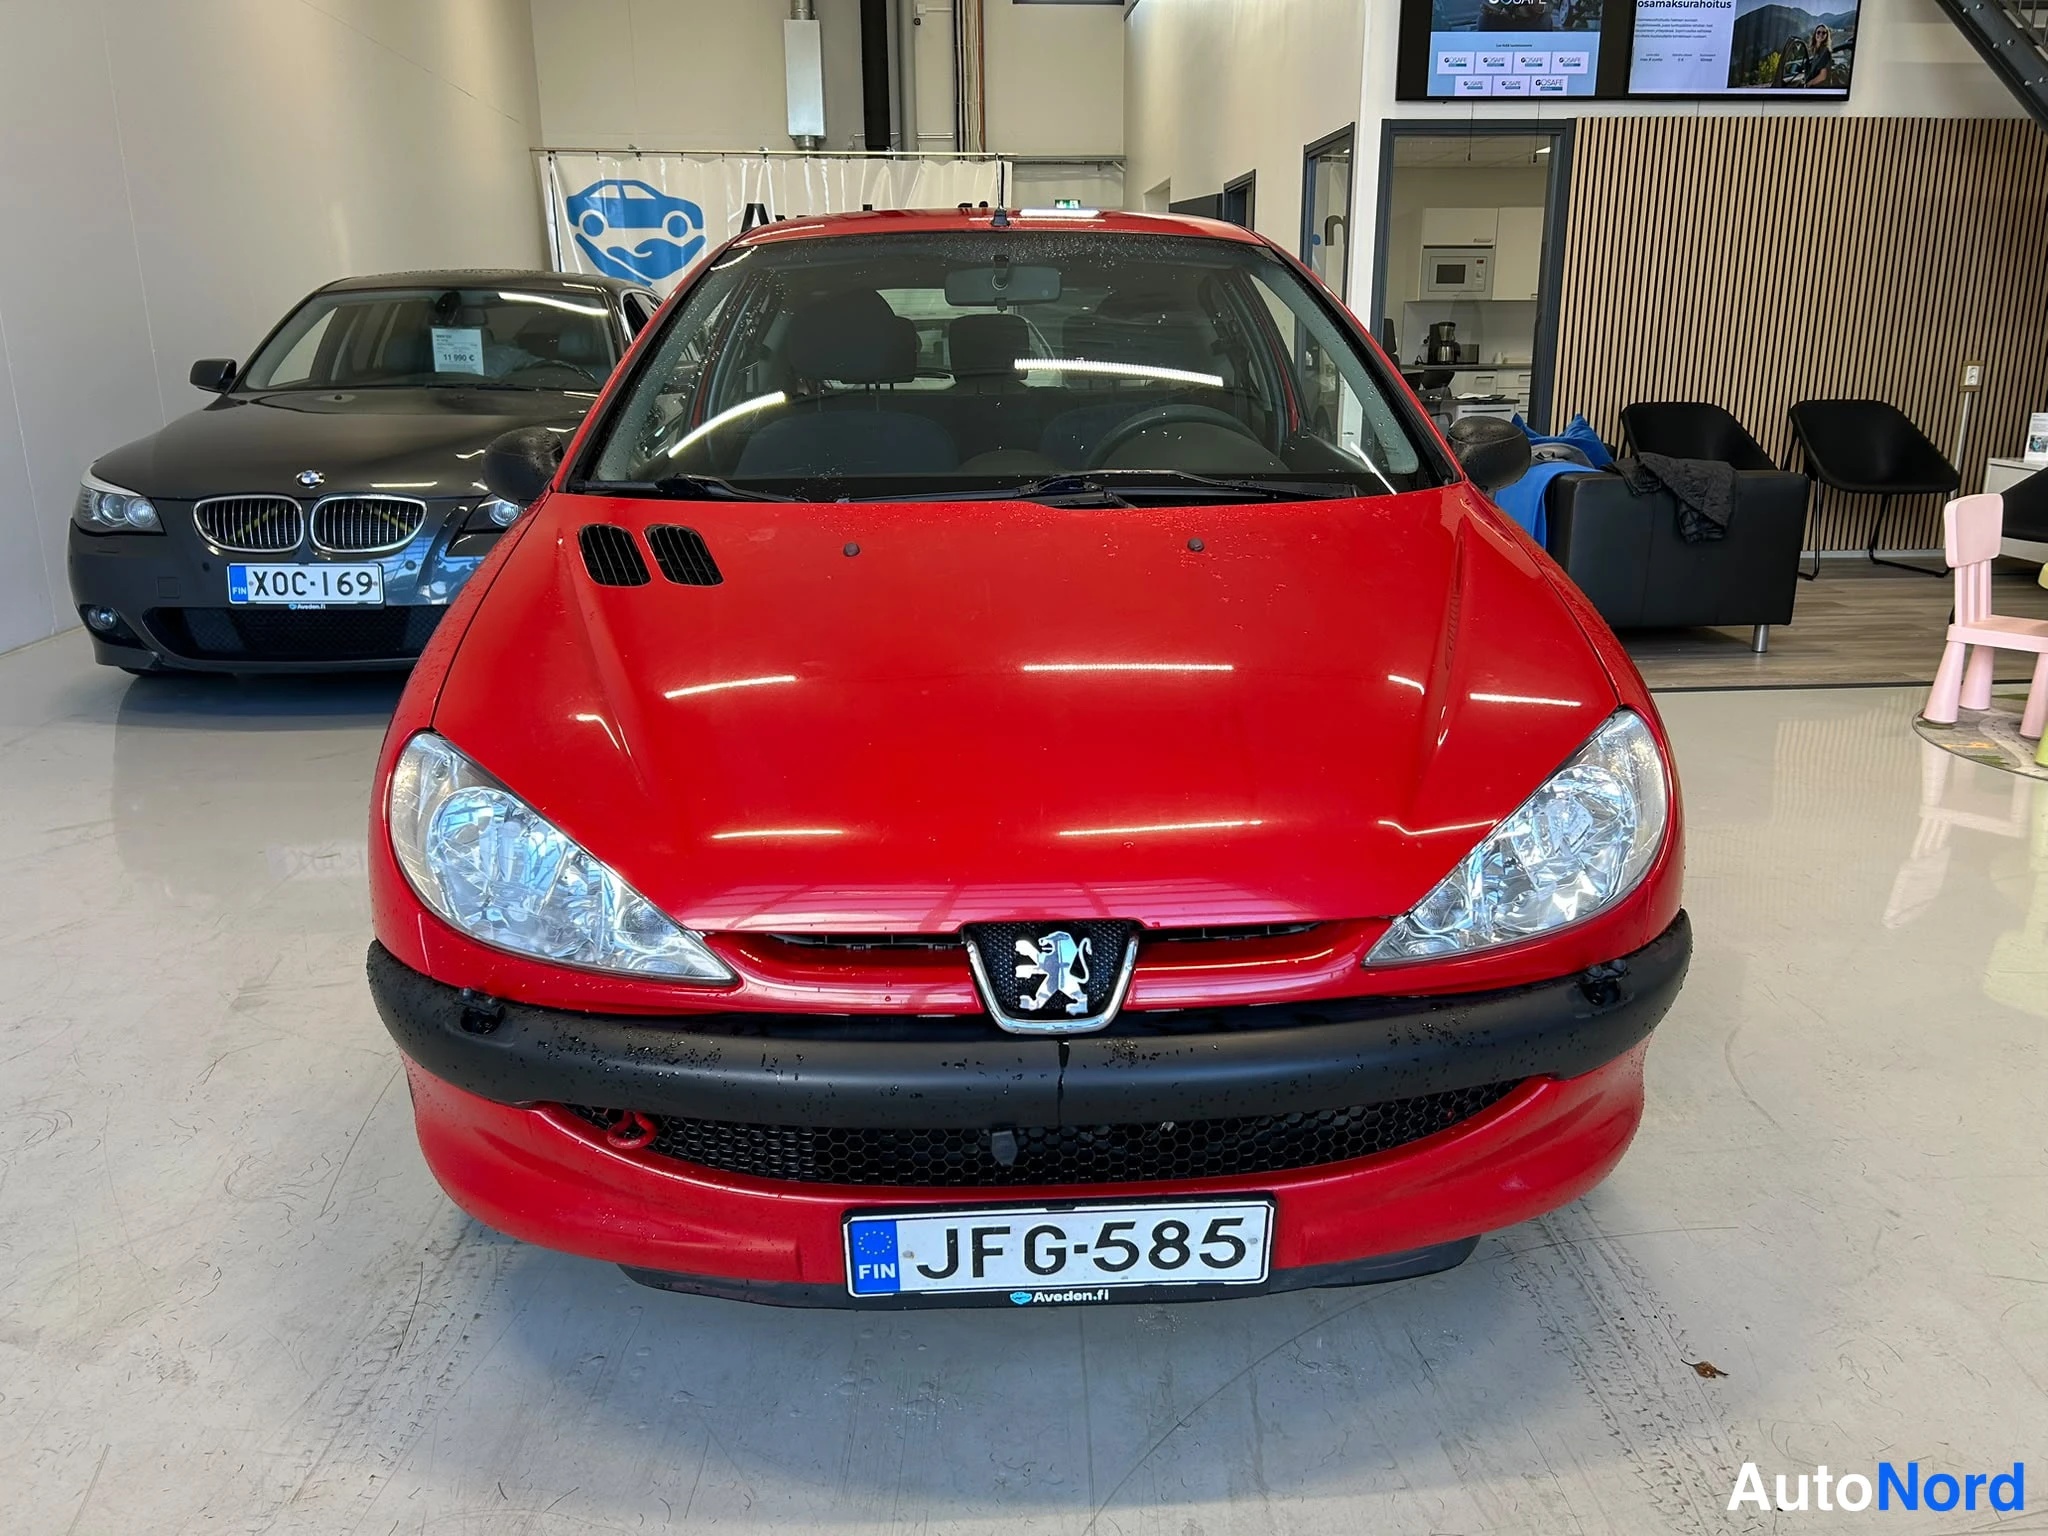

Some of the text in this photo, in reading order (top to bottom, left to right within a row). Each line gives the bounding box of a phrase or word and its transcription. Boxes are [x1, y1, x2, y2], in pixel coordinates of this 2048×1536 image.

[1637, 0, 1732, 8] osamaksurahoitus
[253, 571, 373, 596] XOC-169
[916, 1217, 1248, 1280] JFG-585
[858, 1263, 896, 1280] FIN
